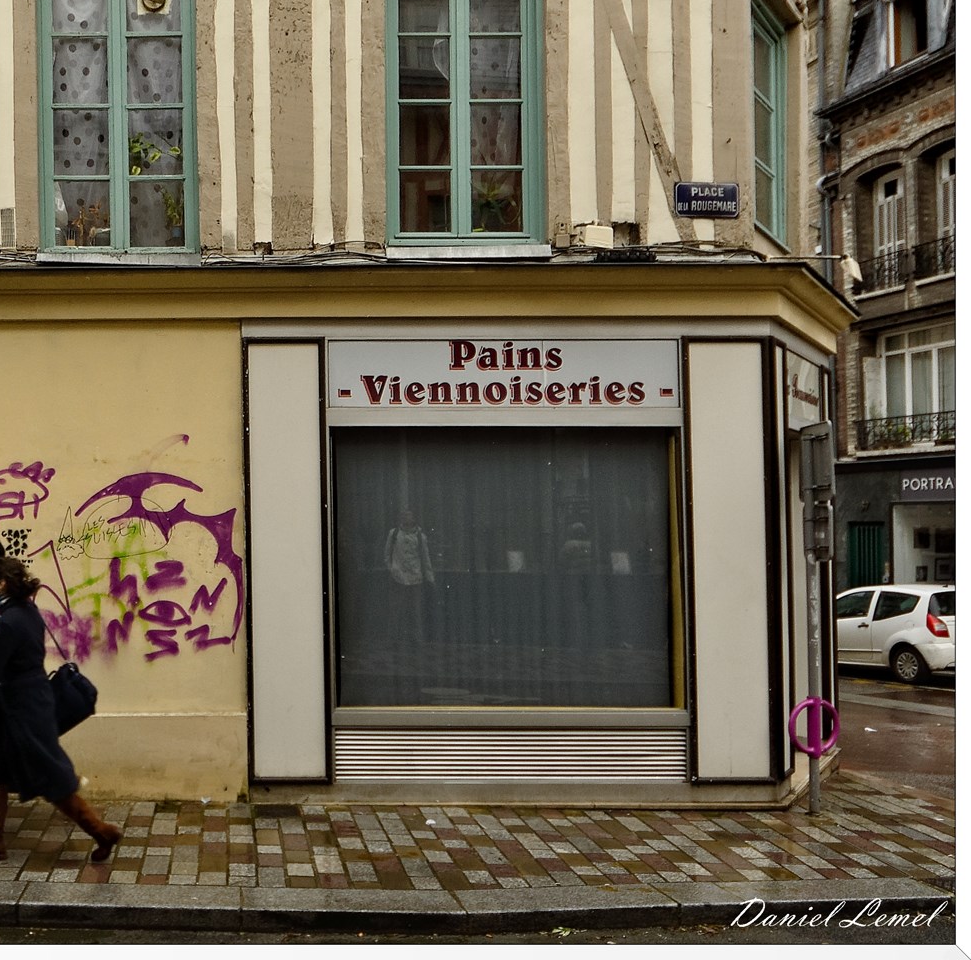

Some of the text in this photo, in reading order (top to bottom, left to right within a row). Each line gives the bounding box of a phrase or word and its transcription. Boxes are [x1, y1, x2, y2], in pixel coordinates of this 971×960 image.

[691, 187, 725, 197] PLACE
[691, 200, 737, 212] ROUGEMARE
[448, 340, 564, 371] Pains
[360, 374, 647, 405] Viennoiseries
[902, 477, 954, 491] PORTRA
